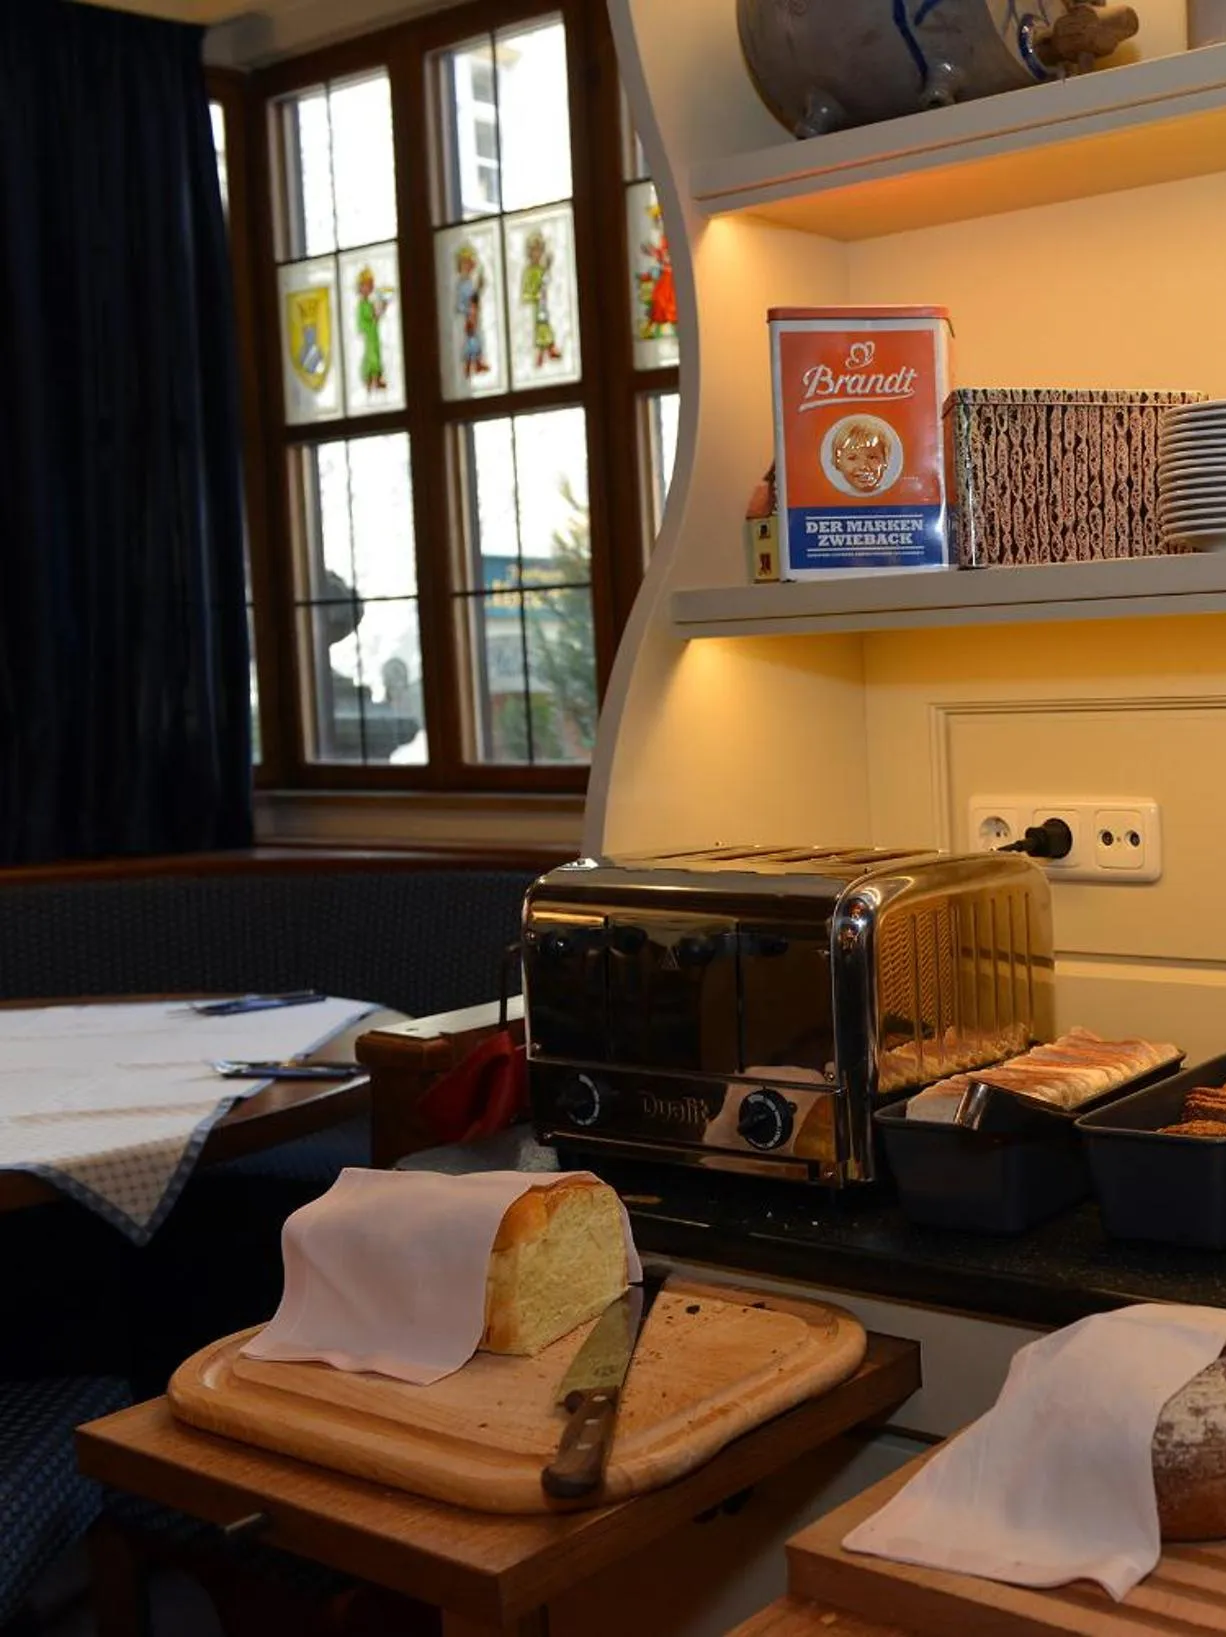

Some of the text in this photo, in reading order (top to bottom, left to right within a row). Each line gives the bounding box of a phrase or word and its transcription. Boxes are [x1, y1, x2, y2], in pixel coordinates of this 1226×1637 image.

[802, 364, 918, 400] Brandt
[806, 519, 924, 534] DER MARKEN
[818, 533, 913, 547] ZWIEBACK
